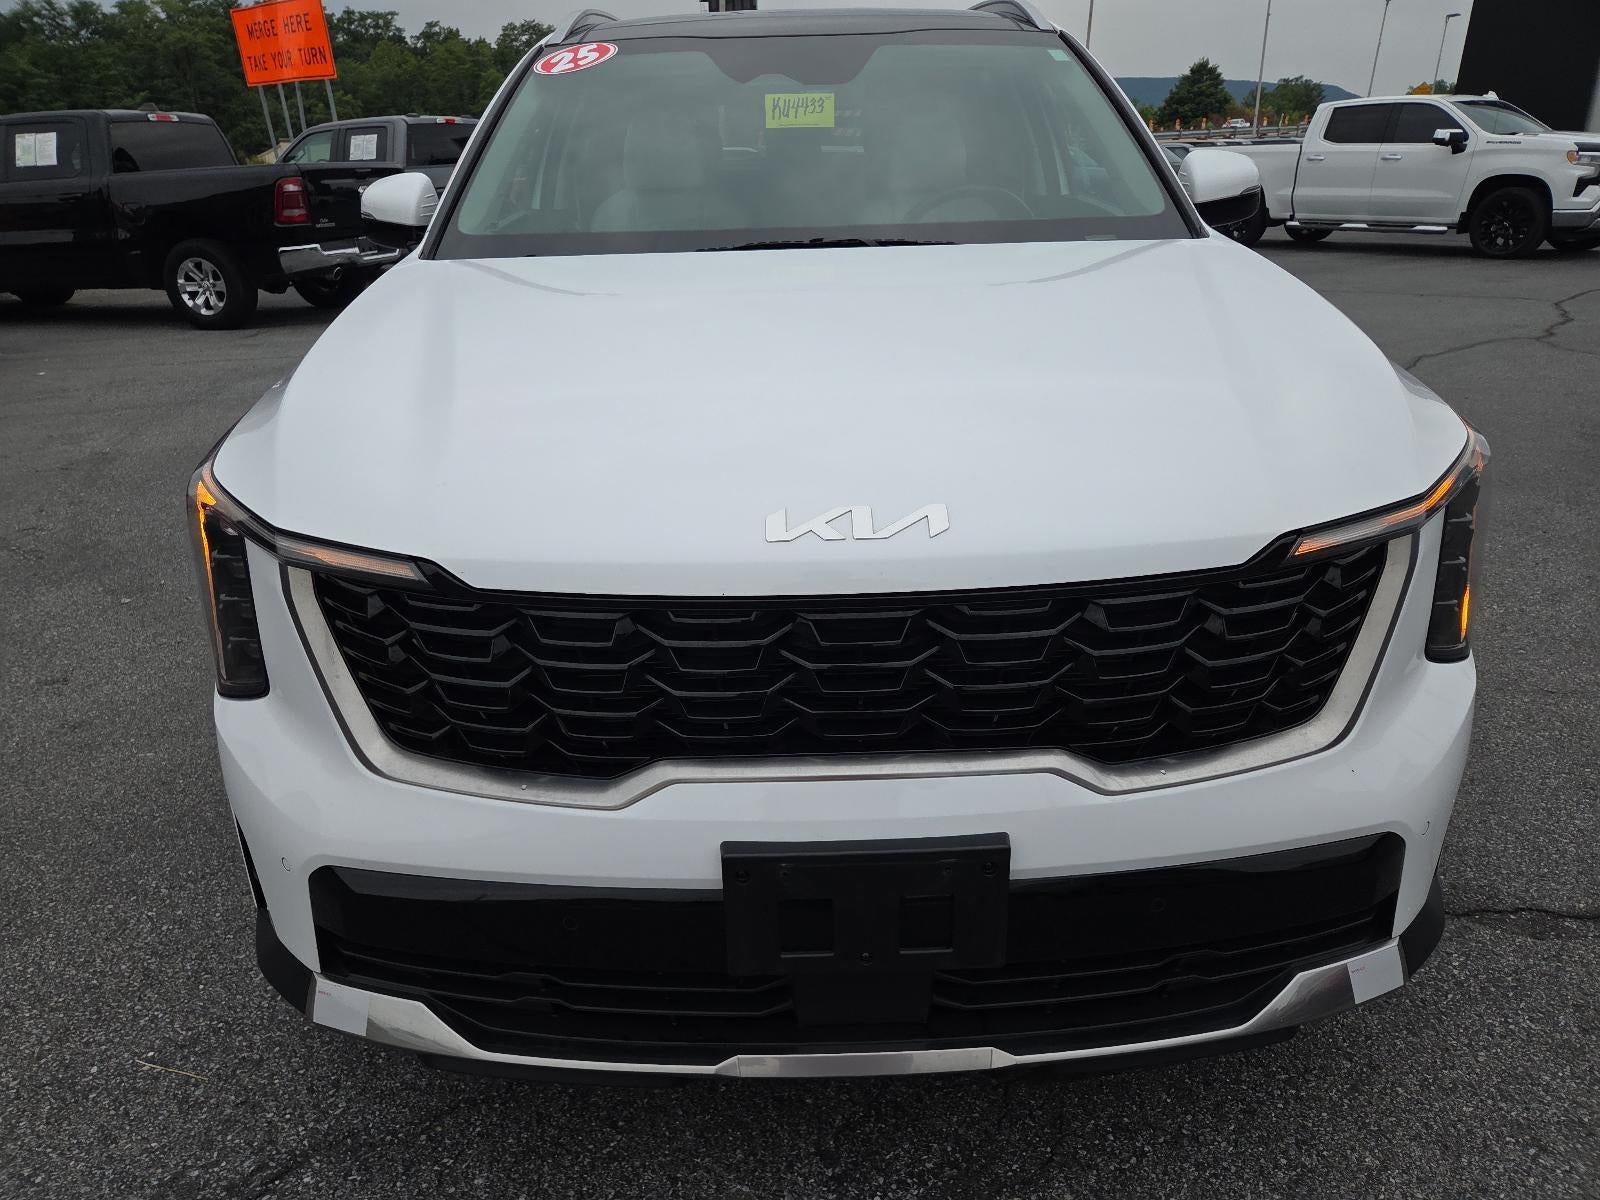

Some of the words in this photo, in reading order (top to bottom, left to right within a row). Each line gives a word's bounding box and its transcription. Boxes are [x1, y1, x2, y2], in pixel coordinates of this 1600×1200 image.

[246, 19, 278, 40] MERGE
[282, 13, 312, 33] HERE
[247, 54, 268, 72] TAKE
[270, 49, 293, 69] YOUR
[297, 46, 327, 66] TURN
[550, 44, 600, 72] 25
[765, 503, 950, 543] KIA
